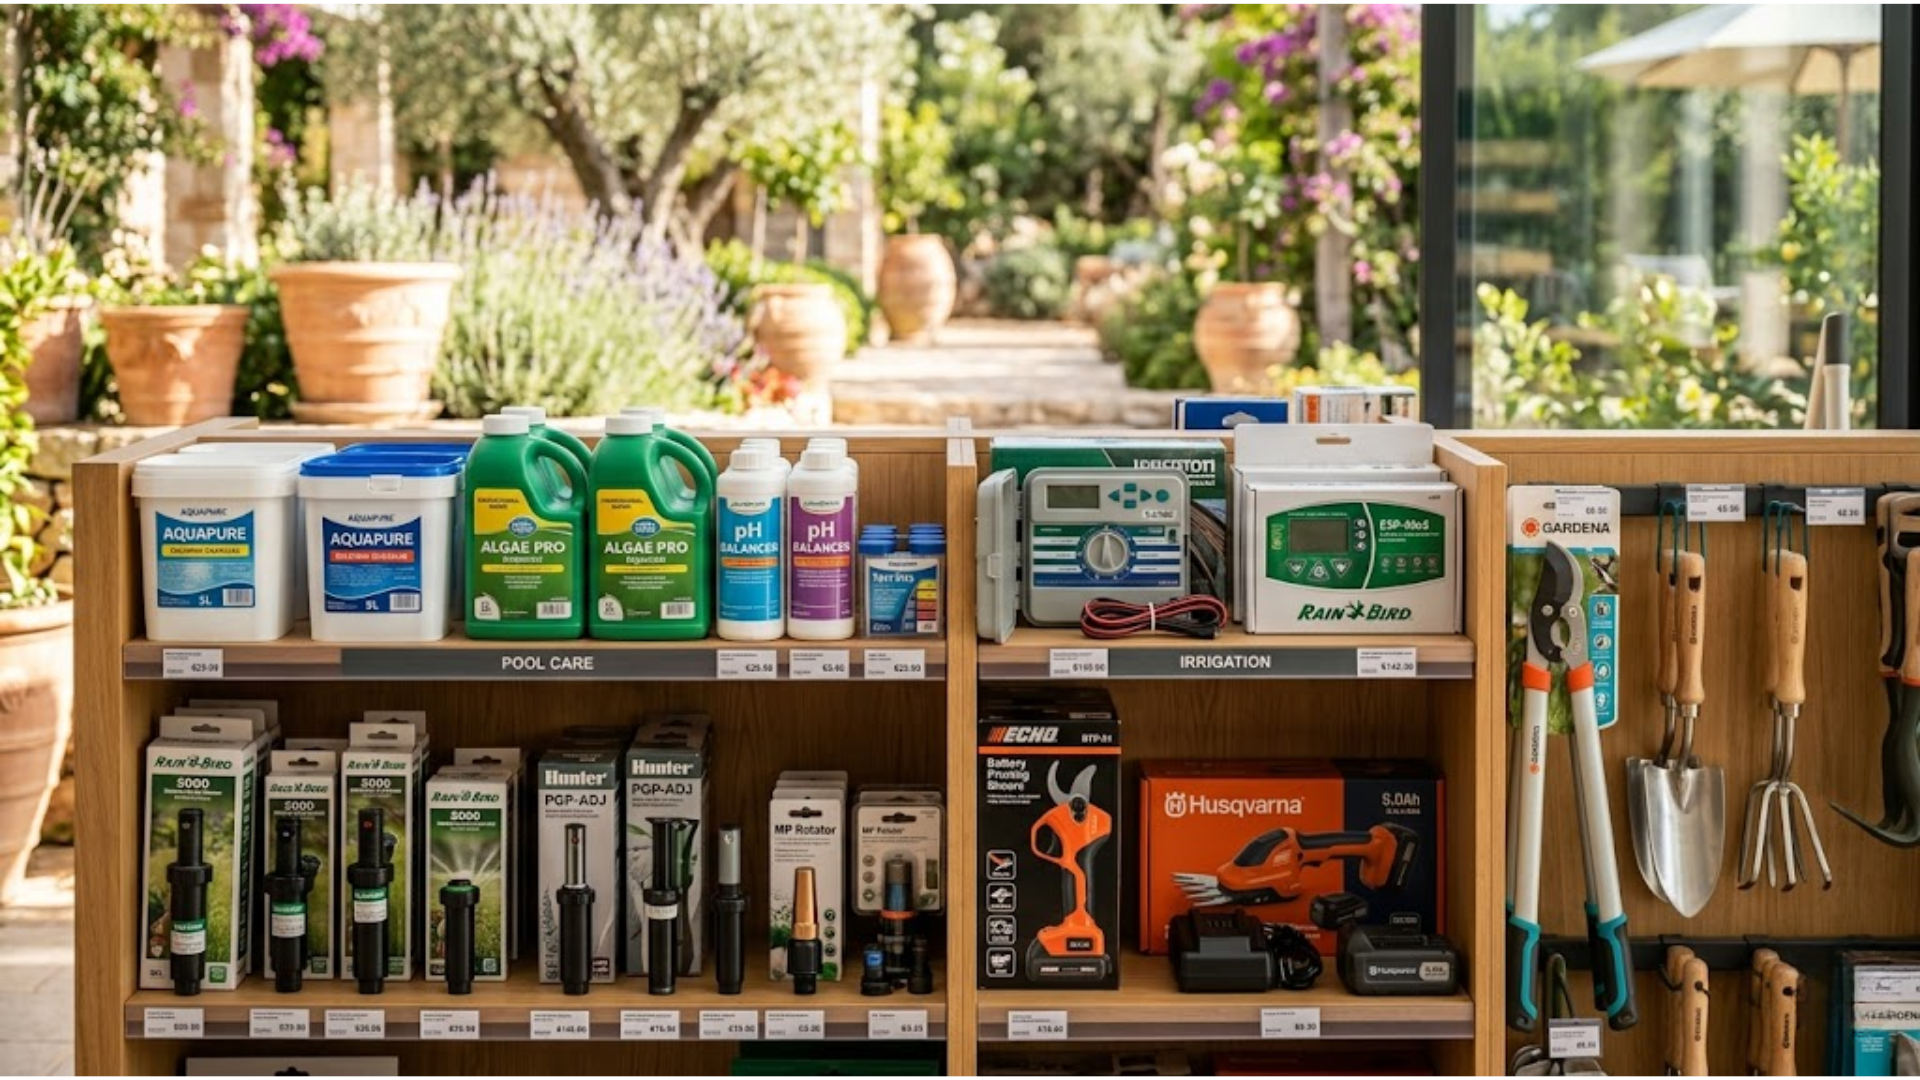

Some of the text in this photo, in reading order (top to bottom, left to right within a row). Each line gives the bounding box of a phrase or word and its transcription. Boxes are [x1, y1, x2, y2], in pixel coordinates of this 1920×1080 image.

[163, 526, 246, 542] AQUAPURE
[734, 522, 762, 542] pH
[807, 522, 835, 542] pH
[1542, 522, 1611, 534] GARDENA
[330, 532, 414, 548] AQUAPURE
[480, 540, 566, 554] ALGAE PRO
[604, 541, 689, 555] ALGAE PRO
[1298, 603, 1412, 621] RAIN BIRD
[502, 656, 594, 670] POOL CARE
[1180, 656, 1272, 669] IRRIGATION
[1003, 726, 1058, 744] ECHO
[631, 759, 694, 776] Hunter
[544, 770, 608, 786] Hunter
[632, 783, 694, 796] PGP-ADJ
[544, 794, 608, 807] PGP-ADJ
[1189, 794, 1303, 818] Husqvarna
[774, 824, 837, 835] MP Rotator
